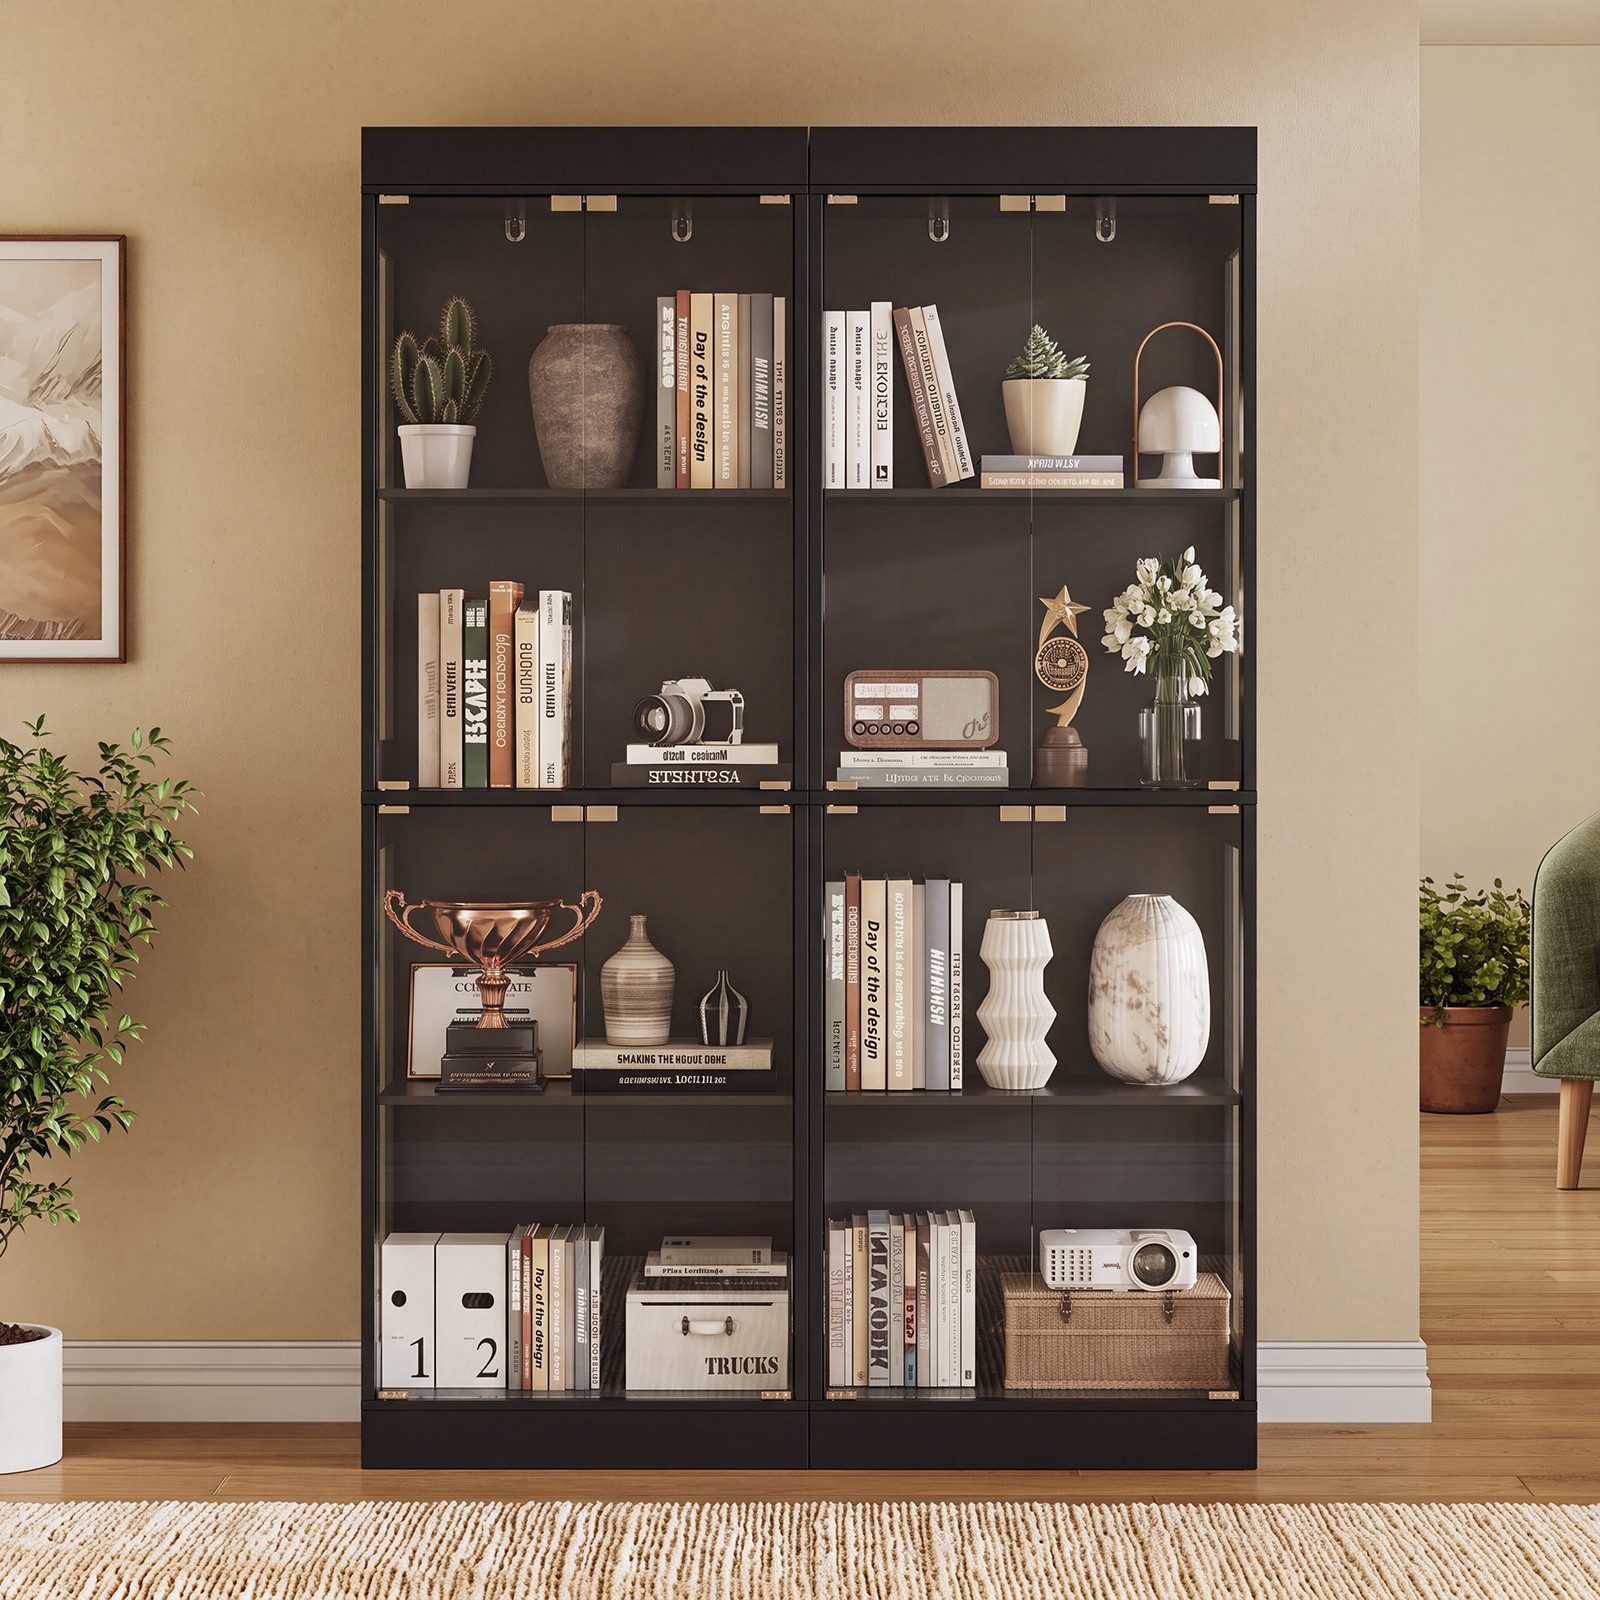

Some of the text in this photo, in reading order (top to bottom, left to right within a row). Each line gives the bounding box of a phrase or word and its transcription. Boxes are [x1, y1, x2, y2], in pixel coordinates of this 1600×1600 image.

[693, 331, 708, 462] Day of the design
[864, 920, 881, 1060] Day of the design
[658, 1054, 674, 1064] THE
[535, 1293, 545, 1305] of
[535, 1307, 545, 1327] the
[410, 1336, 430, 1378] 1
[476, 1337, 499, 1378] 2
[704, 1355, 779, 1375] TRUCKS
